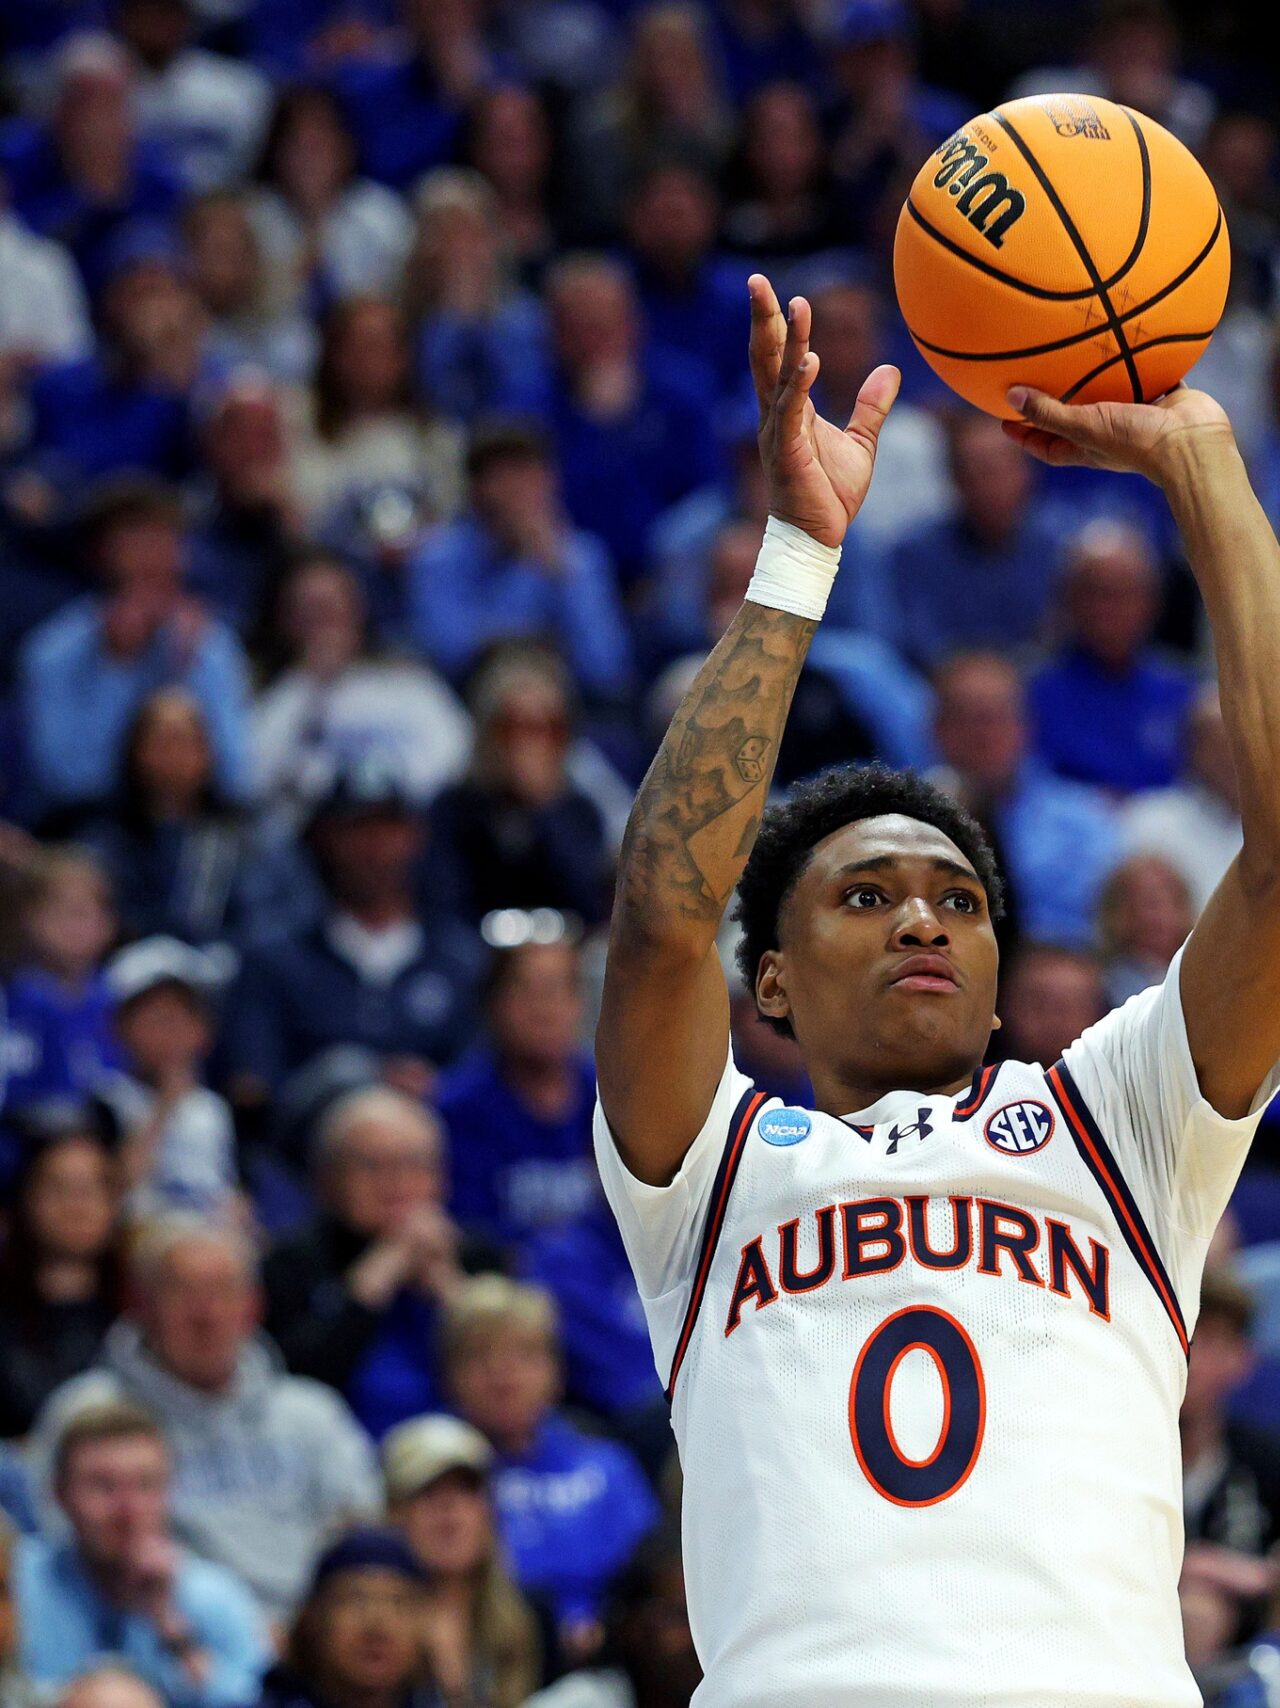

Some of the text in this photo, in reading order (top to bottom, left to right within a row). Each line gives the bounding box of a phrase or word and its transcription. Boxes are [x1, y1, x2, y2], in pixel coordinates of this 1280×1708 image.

[933, 128, 1026, 250] Wils
[764, 1123, 808, 1136] NCAA
[989, 1103, 1049, 1151] SEC
[724, 1194, 1111, 1338] AUBURN
[848, 1304, 987, 1508] 0
